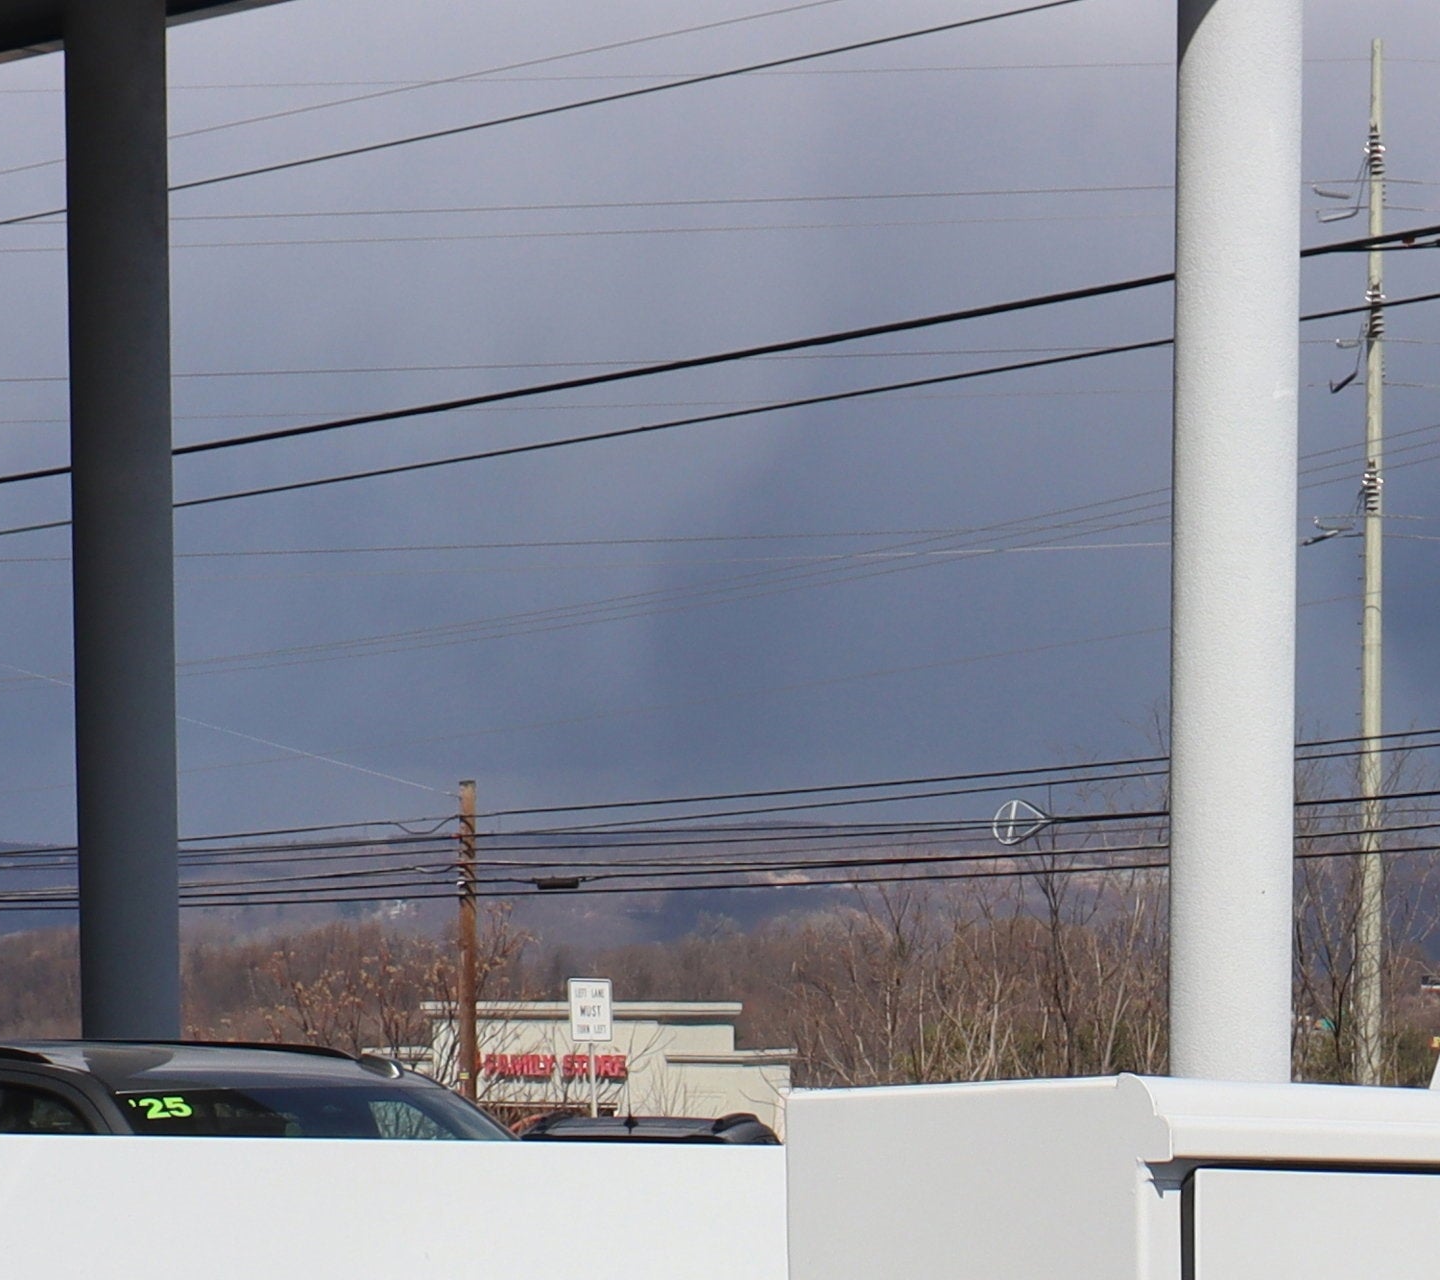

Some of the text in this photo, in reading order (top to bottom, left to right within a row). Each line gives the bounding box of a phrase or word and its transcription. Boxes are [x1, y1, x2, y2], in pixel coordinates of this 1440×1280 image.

[591, 988, 605, 998] LANE
[580, 1005, 601, 1017] MUST
[484, 1054, 555, 1077] FAMILY
